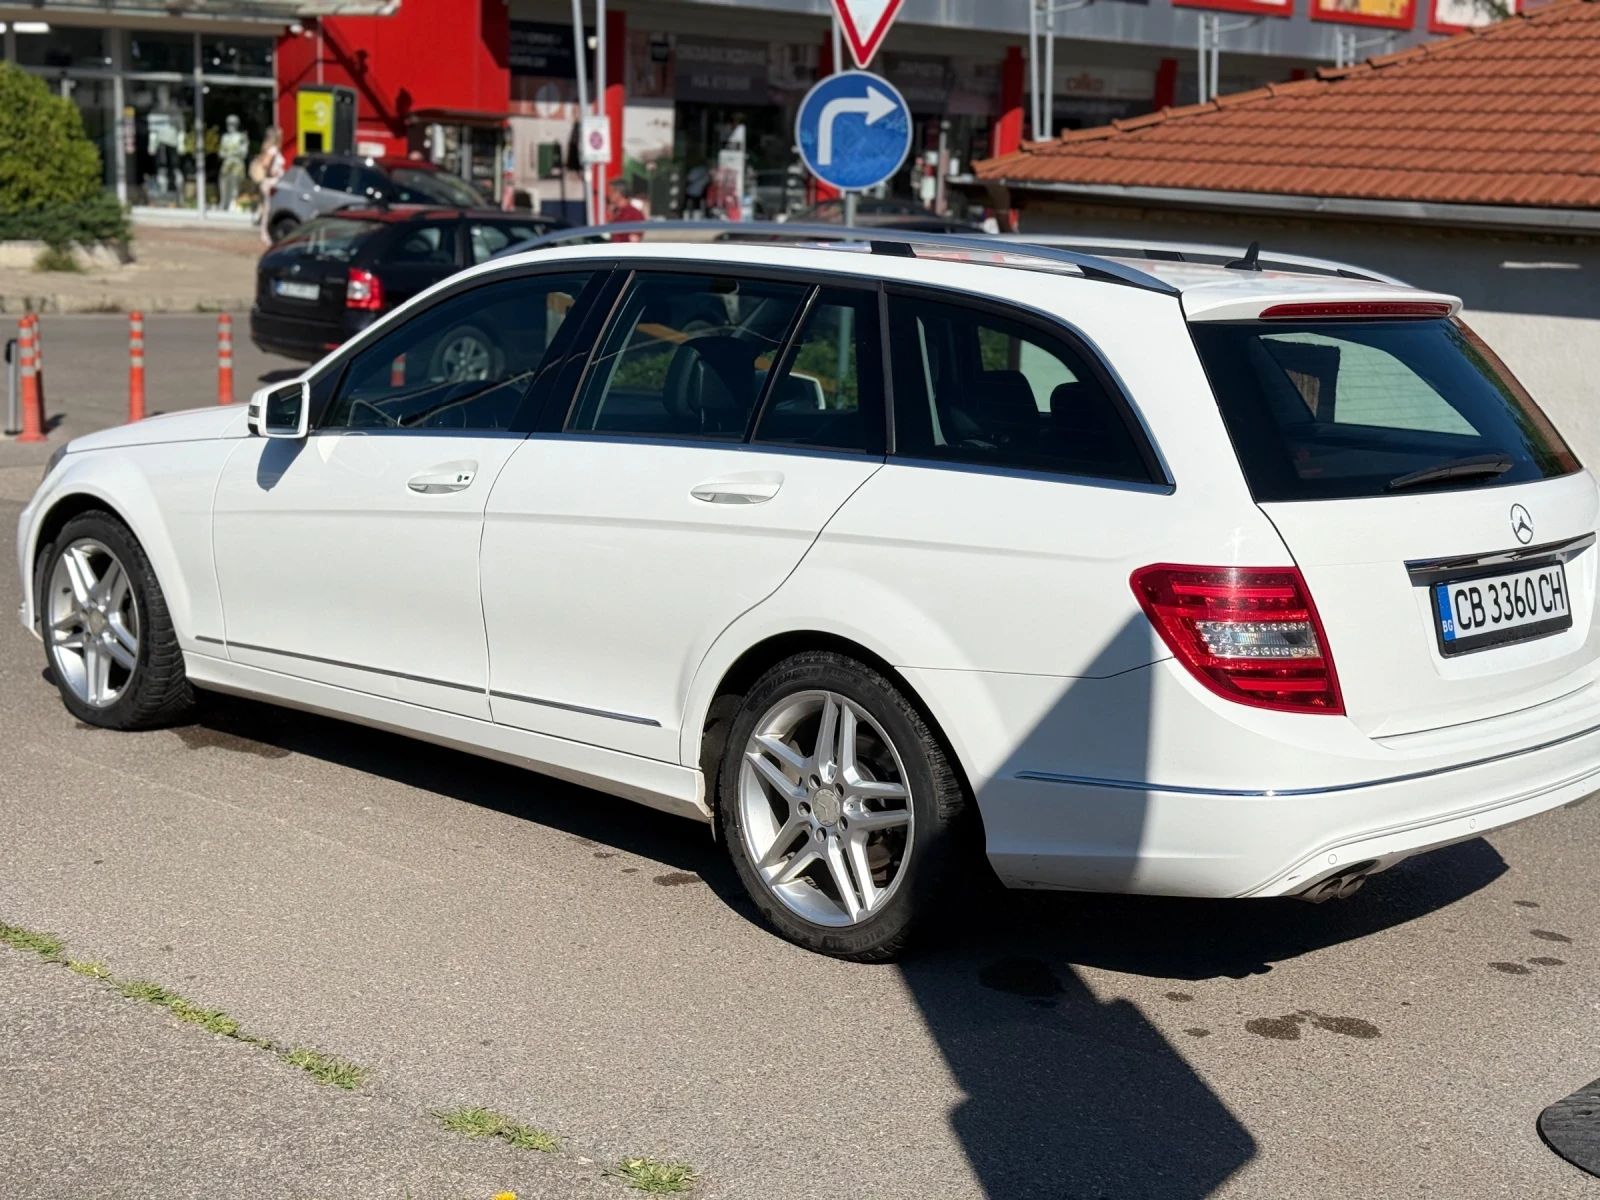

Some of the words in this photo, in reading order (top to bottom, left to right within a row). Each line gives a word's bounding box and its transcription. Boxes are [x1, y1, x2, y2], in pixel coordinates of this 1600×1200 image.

[1454, 586, 1487, 631] CB
[1488, 577, 1537, 624] 3360
[1538, 571, 1565, 613] CH
[1442, 620, 1454, 633] BG
